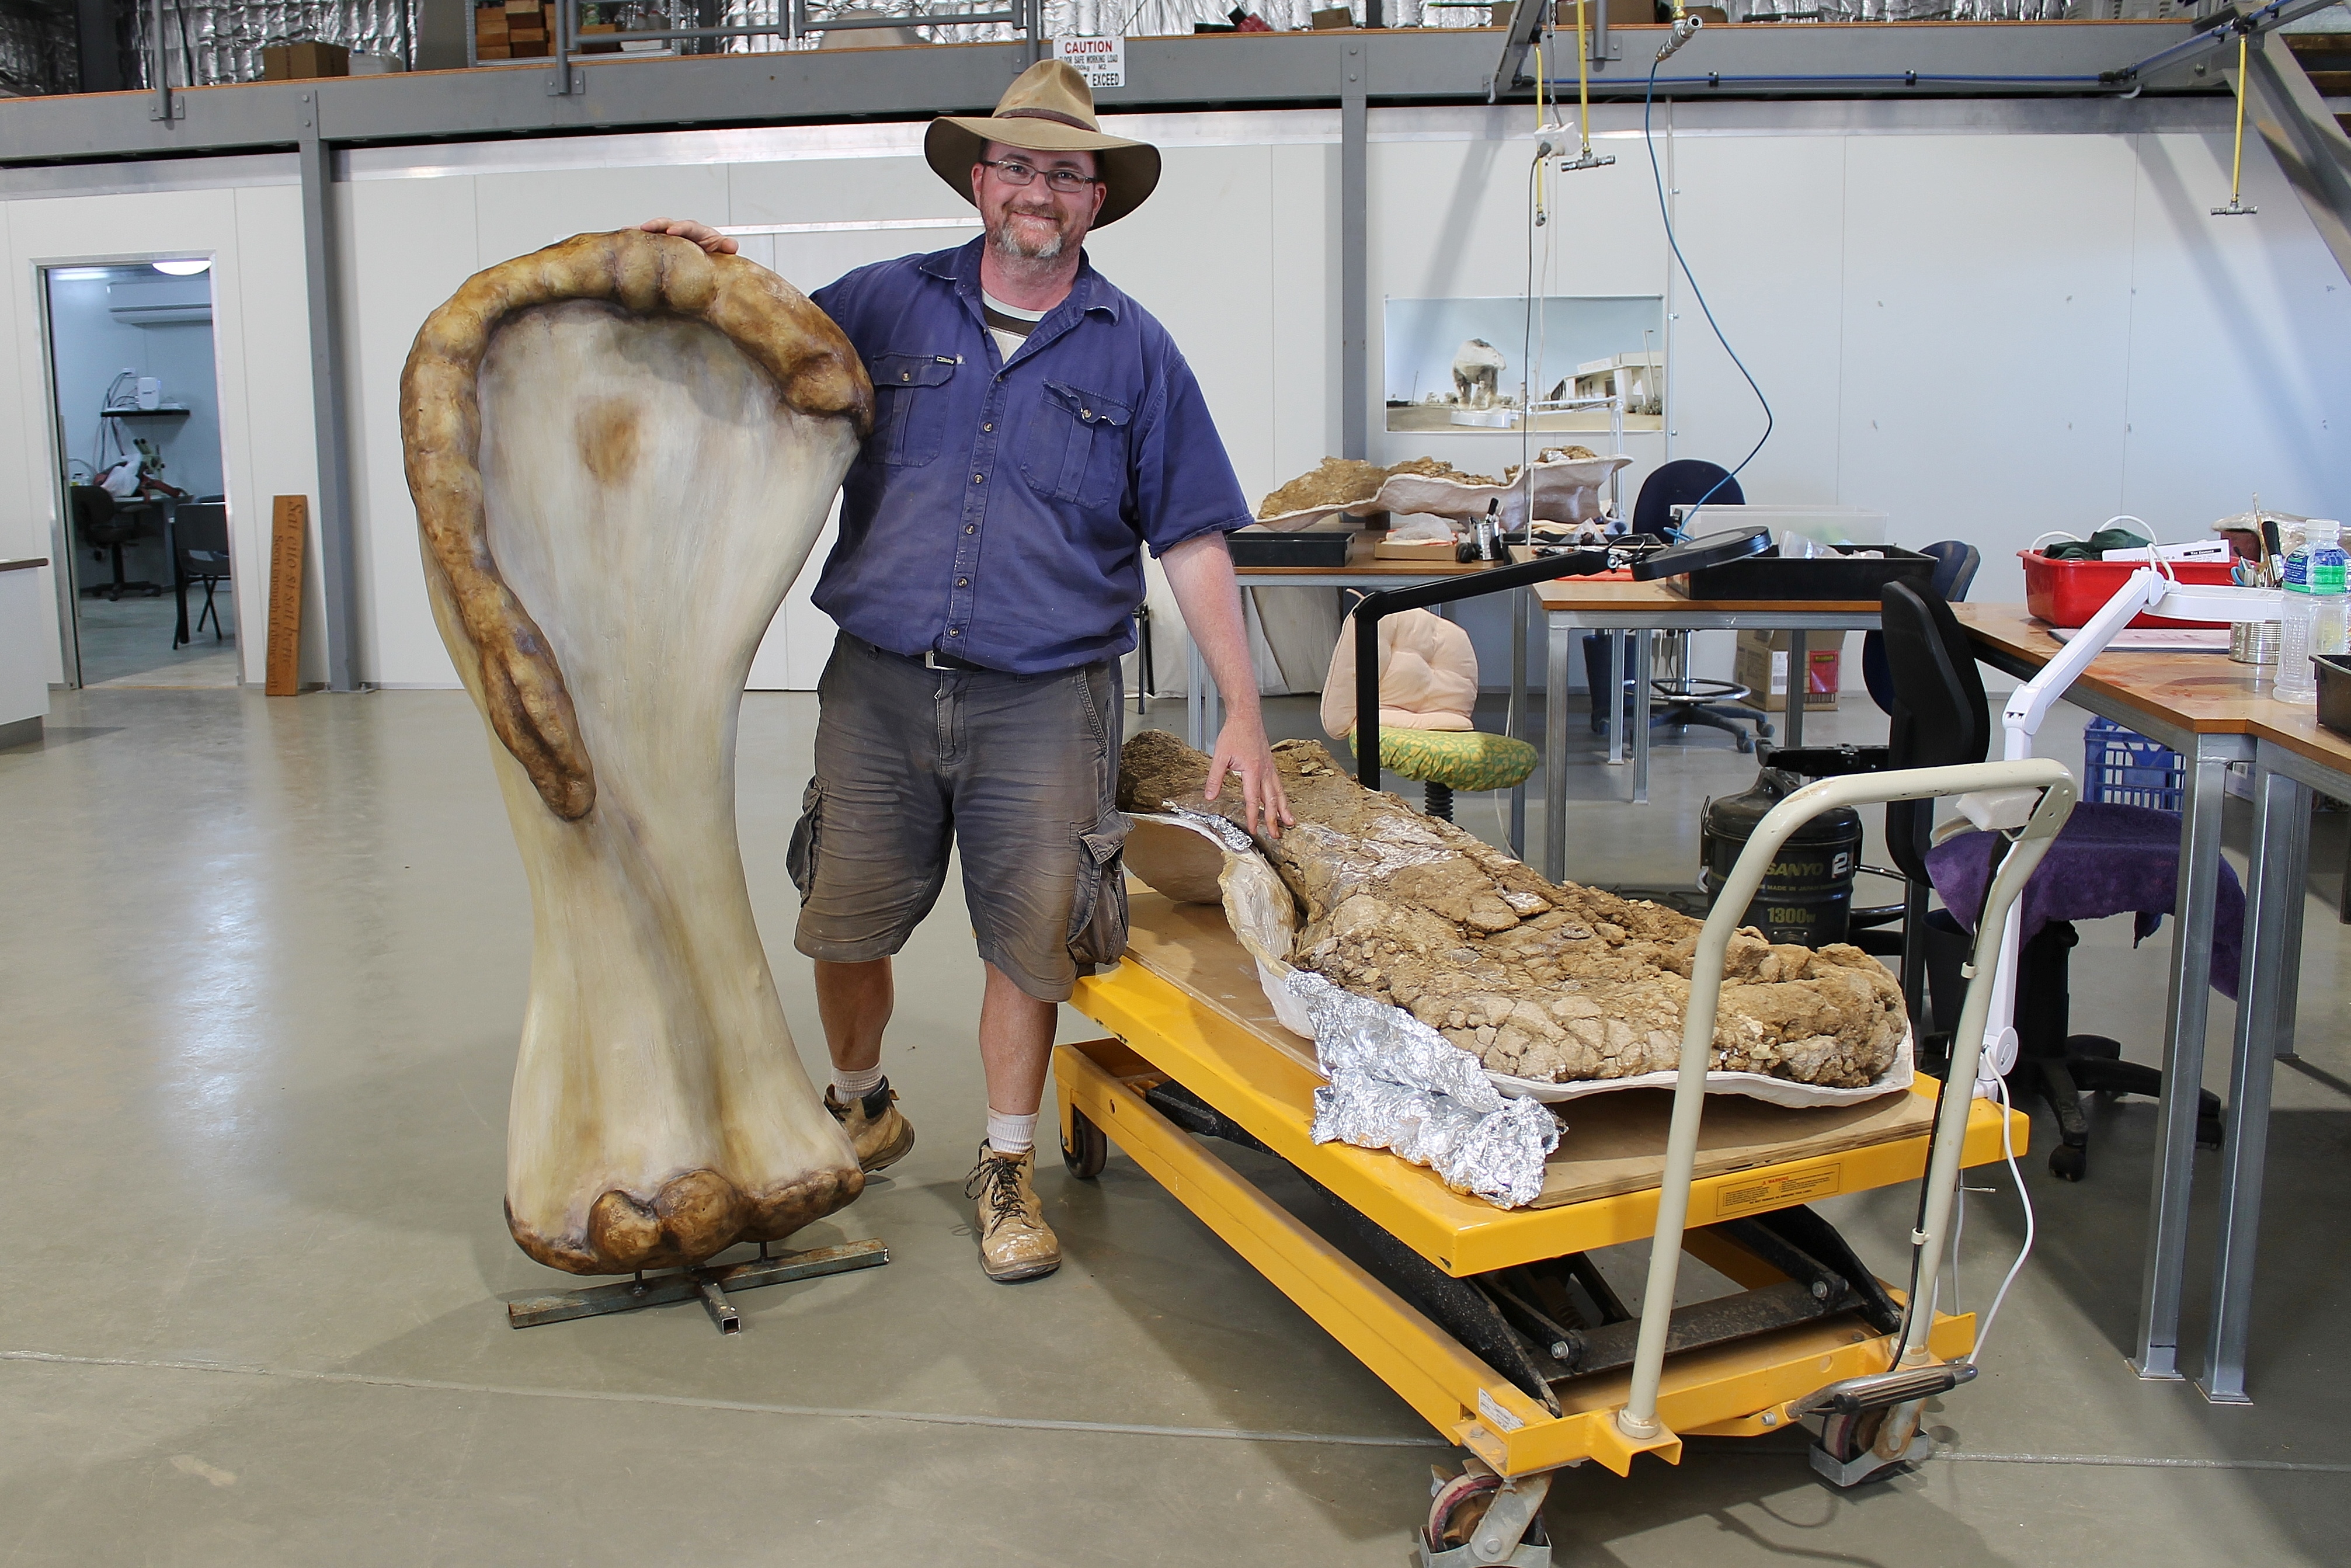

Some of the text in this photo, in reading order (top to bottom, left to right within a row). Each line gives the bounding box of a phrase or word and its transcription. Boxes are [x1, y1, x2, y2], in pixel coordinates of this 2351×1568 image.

[1065, 40, 1112, 54] CAUTION
[1074, 55, 1084, 64] SAFE
[1086, 54, 1105, 63] WORKING
[1107, 54, 1118, 62] LOAD
[1093, 73, 1119, 86] EXCEED
[1765, 862, 1824, 876] SANYO
[1834, 852, 1848, 874] 2
